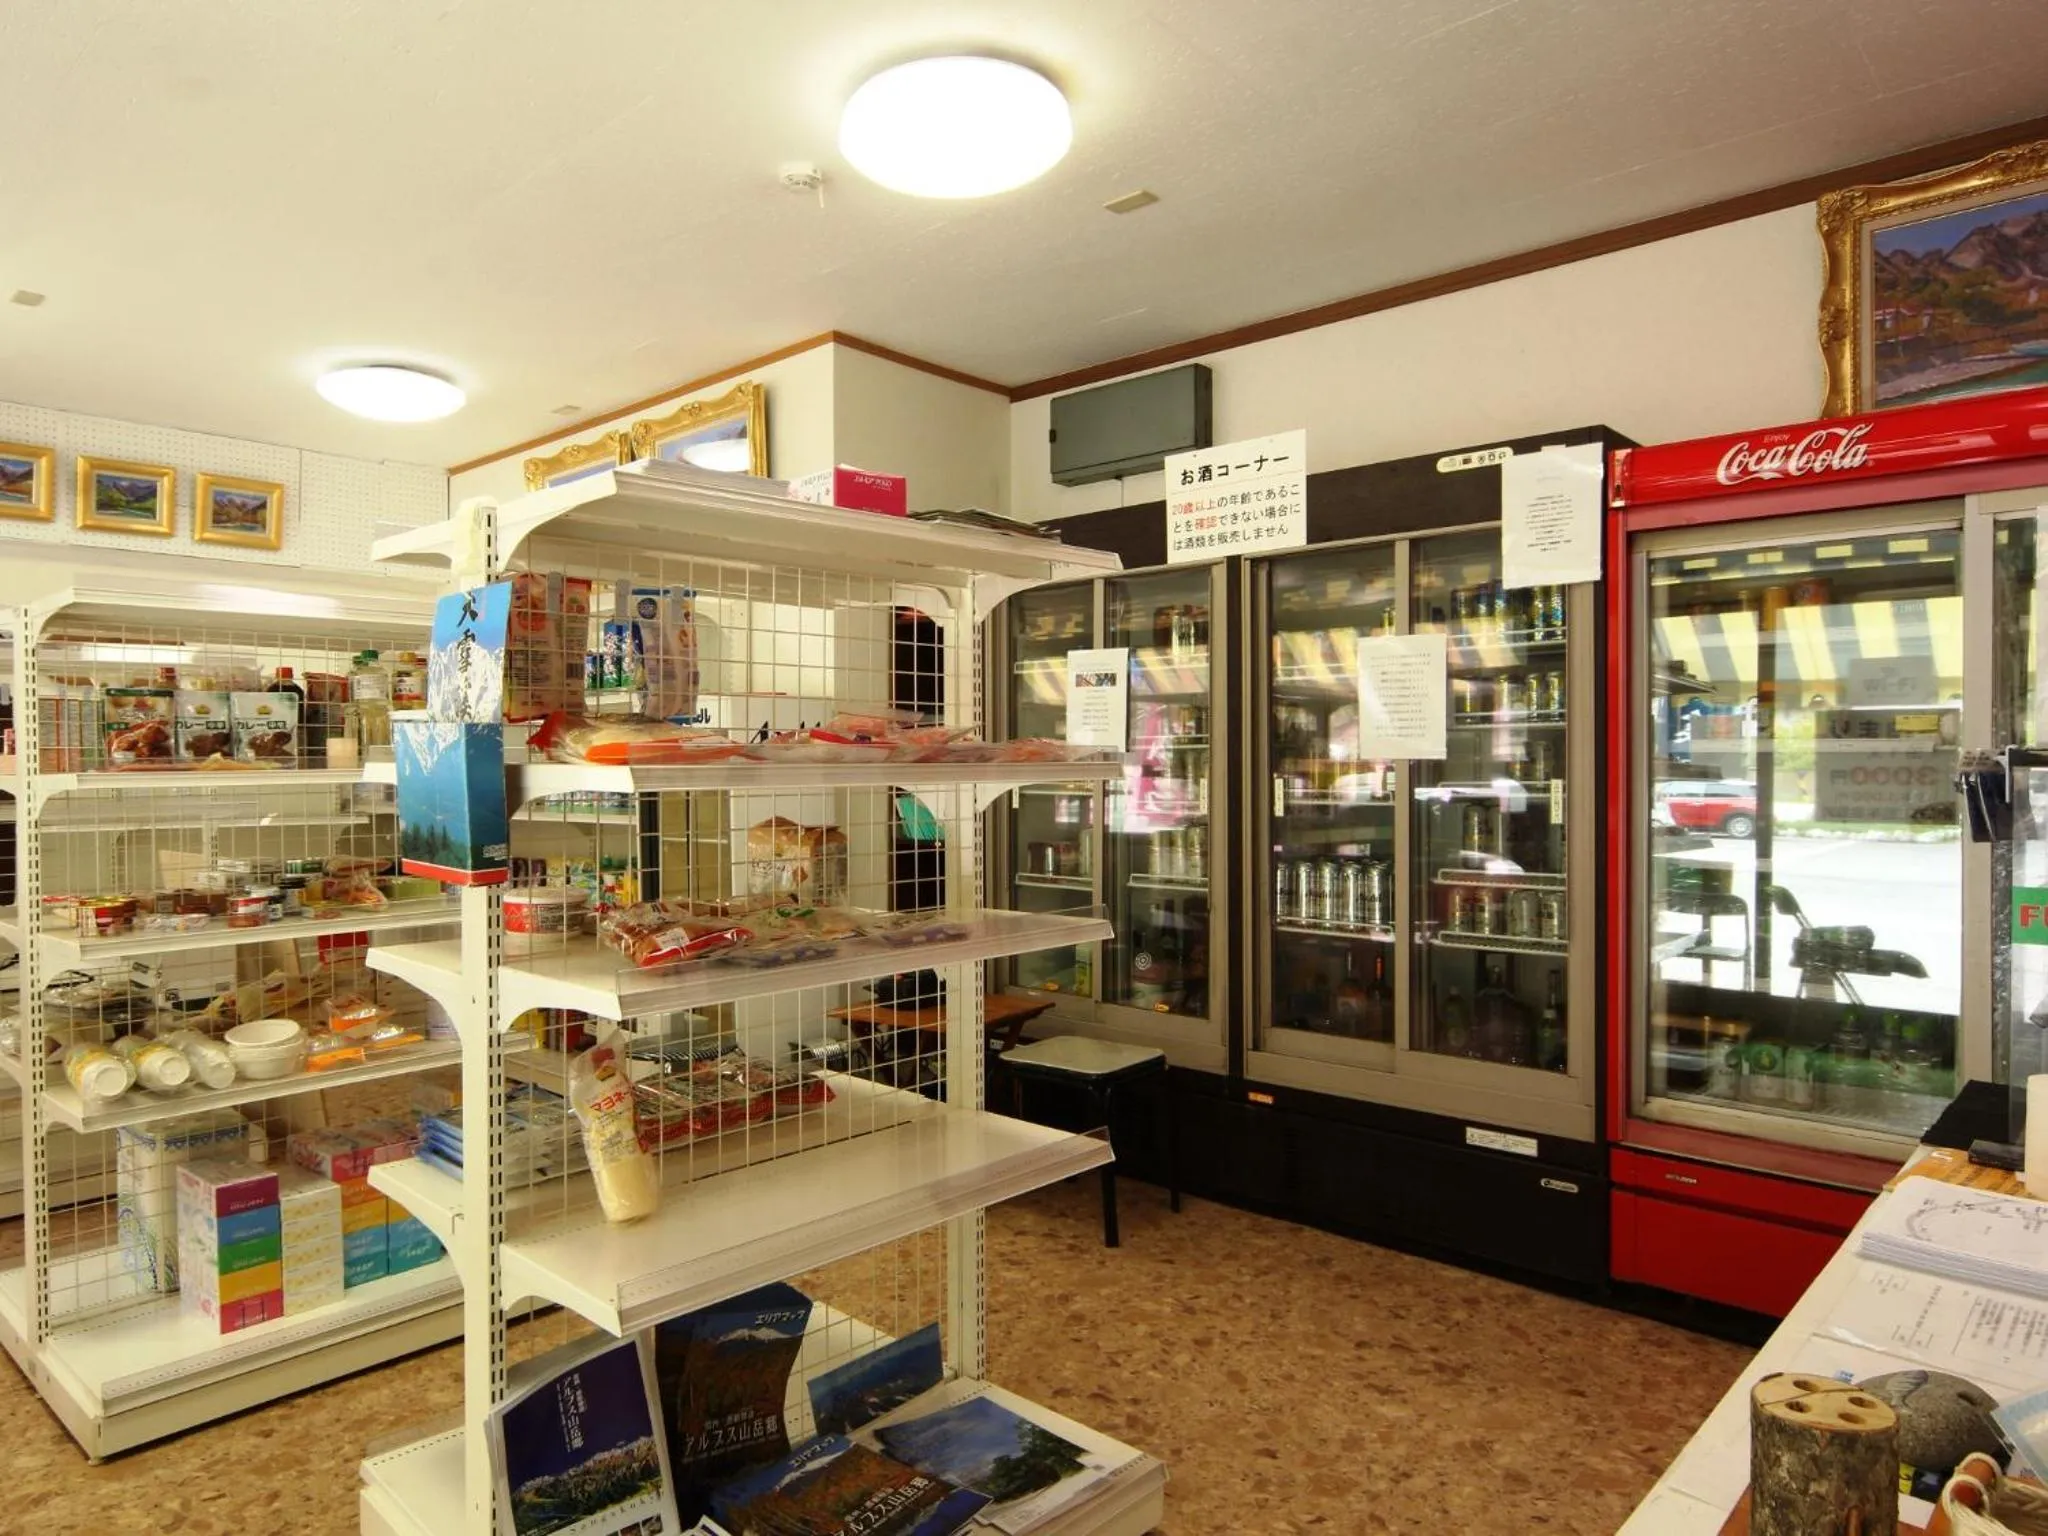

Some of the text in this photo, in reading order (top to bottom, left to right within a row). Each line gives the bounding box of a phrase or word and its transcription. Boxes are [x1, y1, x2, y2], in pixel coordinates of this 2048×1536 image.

[1716, 422, 1874, 486] Coca-Cola
[1180, 454, 1290, 486] お酒コーナー
[1171, 483, 1301, 516] 20歳以上の年齢であるこ
[1173, 503, 1301, 534] とを確認できない場合に
[1173, 523, 1289, 551] は酒類を販売しません
[235, 721, 266, 730] カレー
